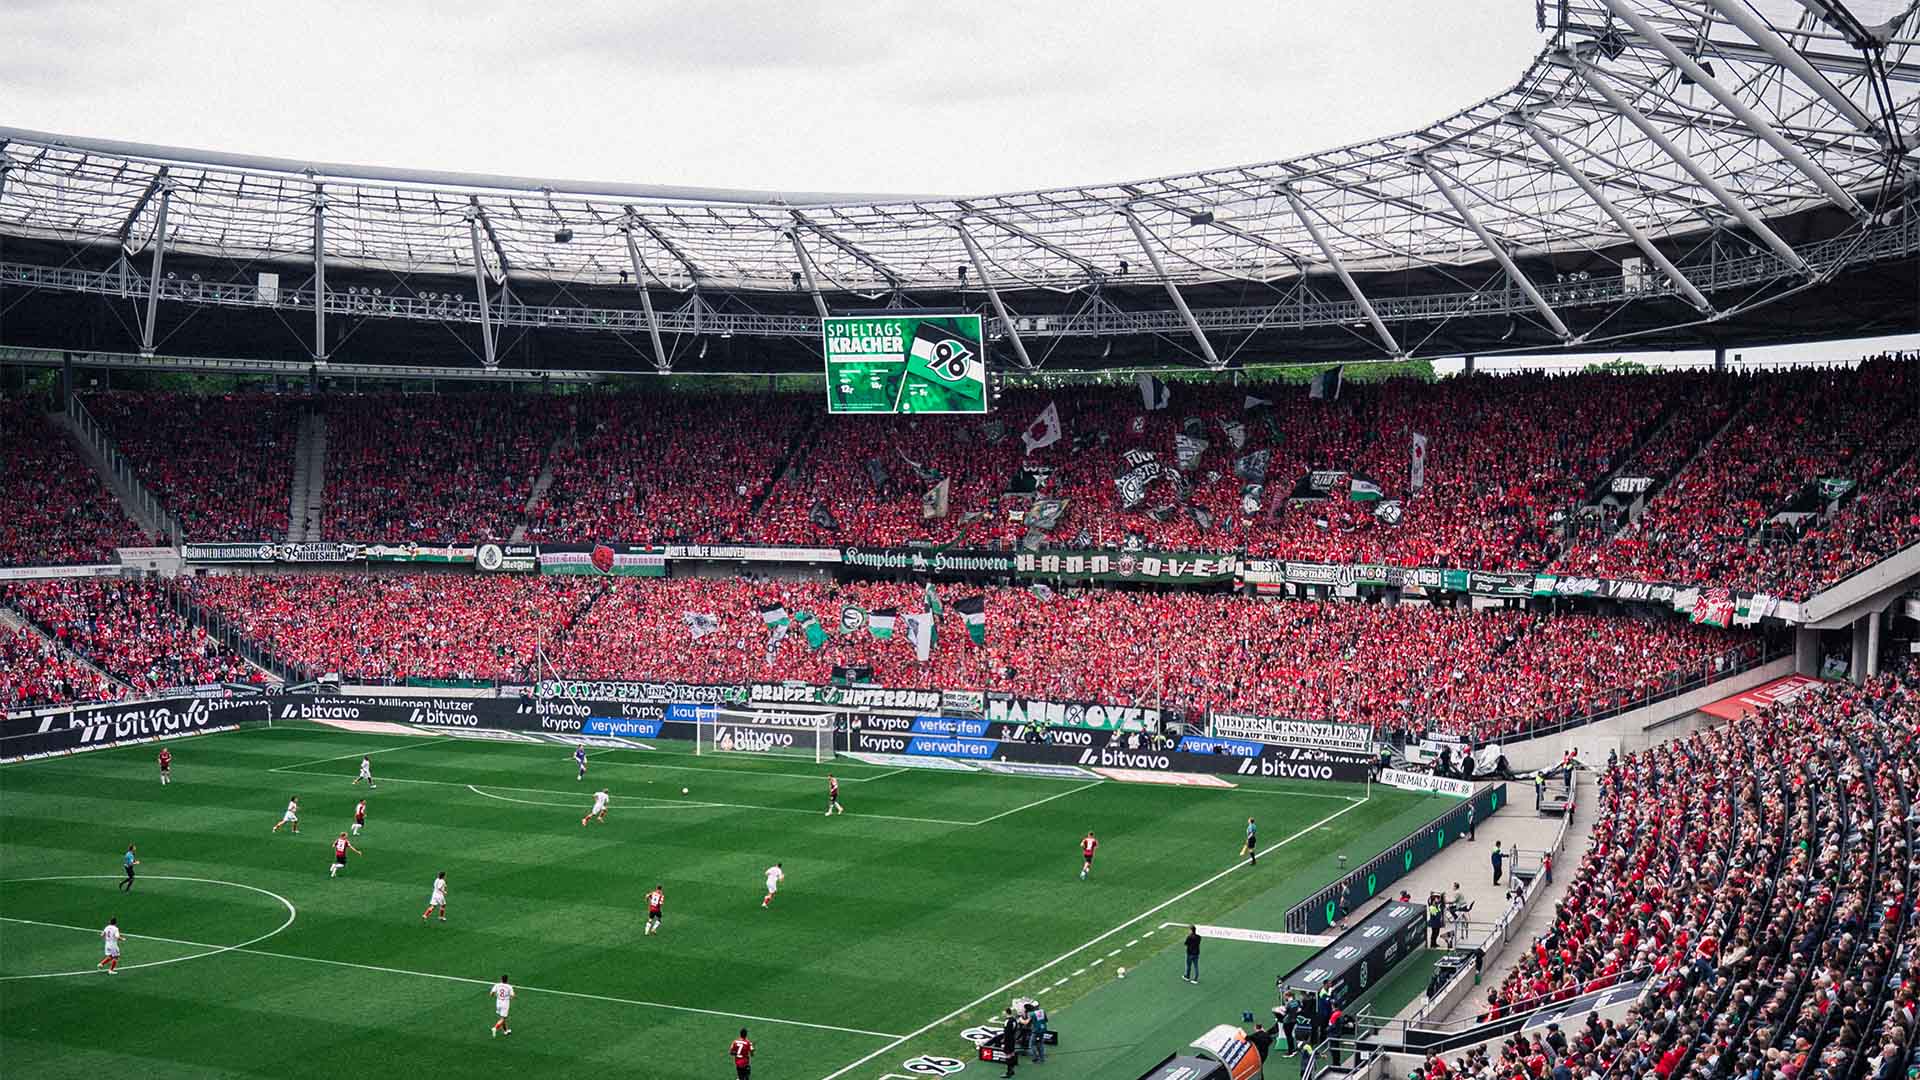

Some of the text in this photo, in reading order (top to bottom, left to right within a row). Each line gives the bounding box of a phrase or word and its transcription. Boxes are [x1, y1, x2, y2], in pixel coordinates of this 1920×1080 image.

[828, 323, 902, 337] SPIELTAGS
[829, 336, 904, 353] KRACHER
[930, 342, 971, 378] 96
[187, 545, 258, 560] SÜDNIEDERSACHSEN
[297, 551, 348, 561] HILDESHEIM
[687, 544, 709, 558] WÖLFE
[845, 547, 1009, 574] Komplott Hannovera
[1286, 564, 1335, 580] Ensemble
[751, 685, 815, 702] GRUPPE
[301, 704, 360, 719] bitvavo
[433, 699, 474, 711] Nutzer
[535, 700, 592, 717] bitvavo
[622, 704, 663, 718] Krypto
[427, 708, 479, 726] bitvavo
[542, 716, 654, 735] Krypto verwahren
[868, 715, 910, 730] Krypto
[734, 727, 793, 746] bitvavo
[859, 734, 988, 756] Krypto verwahren
[1219, 729, 1363, 749] WIRD AUF EWIG DEIN NAME SEIN
[1101, 748, 1170, 769] bitvavo
[1261, 757, 1333, 779] bitvavo
[1395, 773, 1428, 788] NIEMALS
[1431, 779, 1459, 793] ALLEIN!
[736, 1043, 744, 1055] 7
